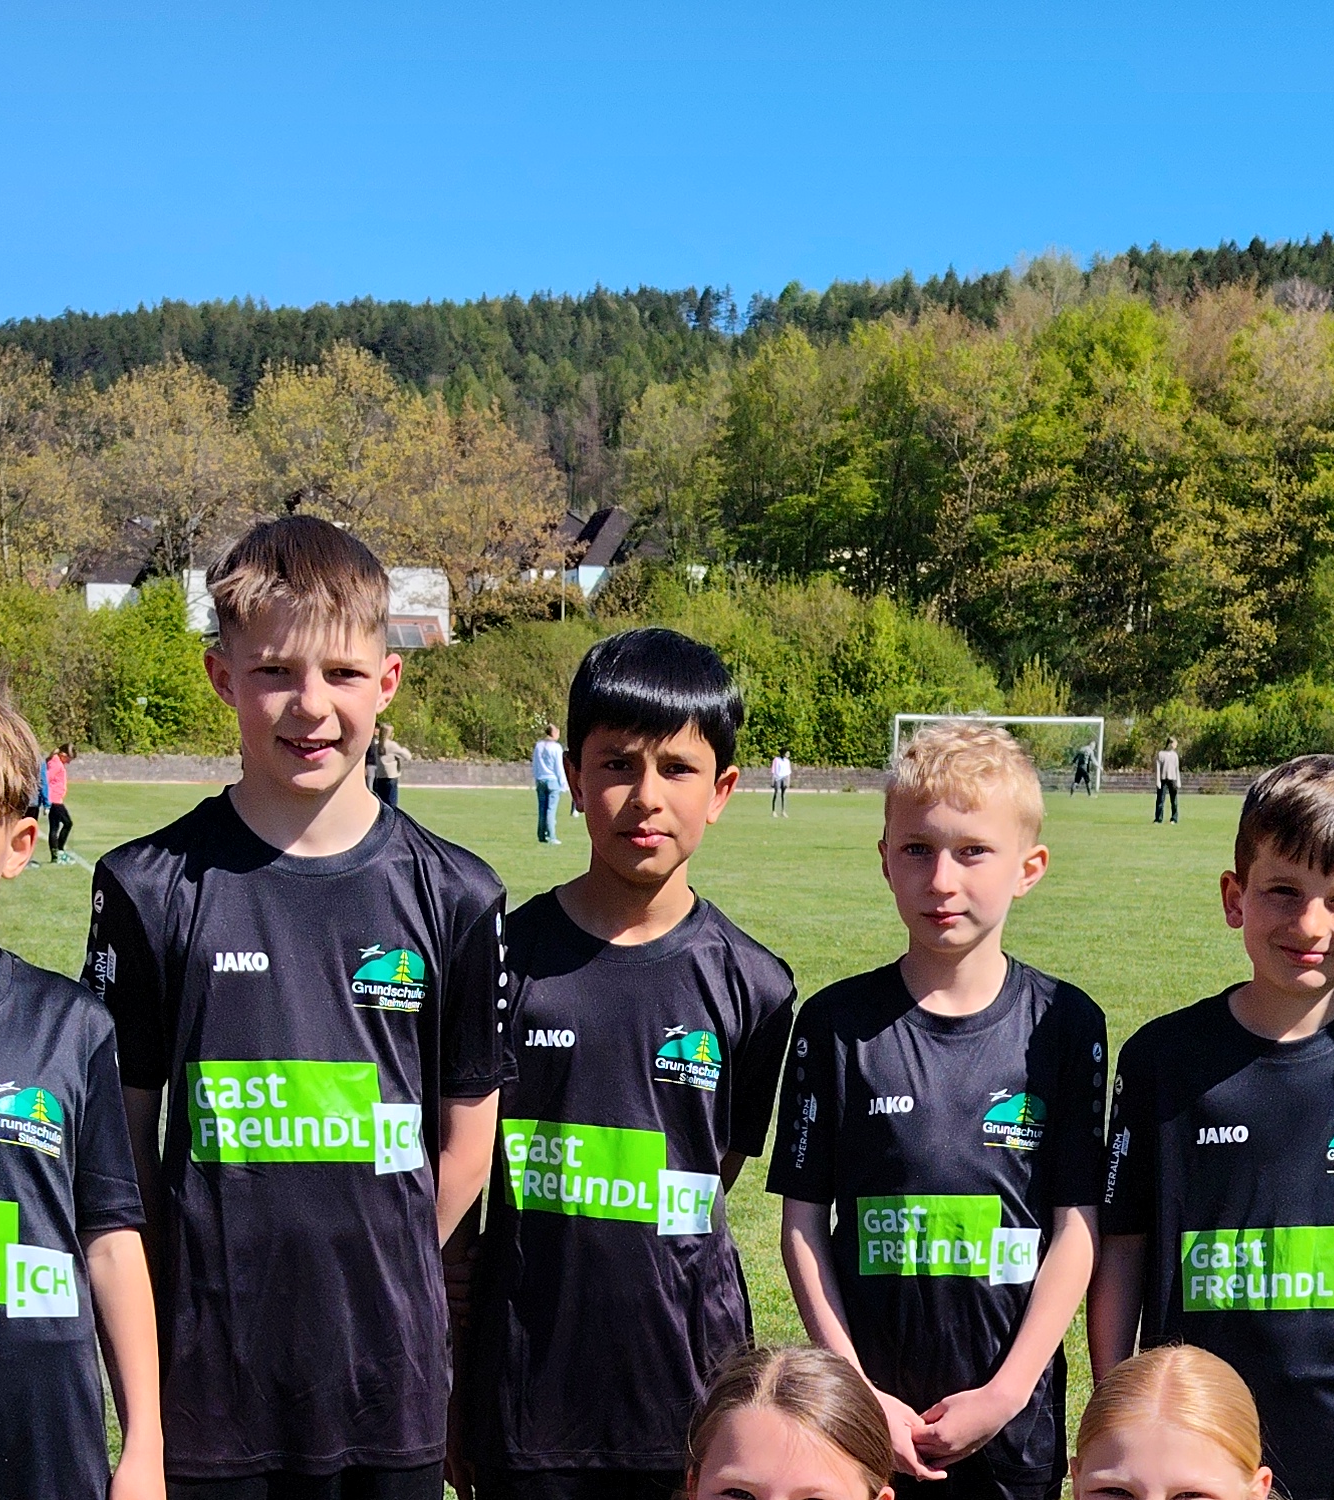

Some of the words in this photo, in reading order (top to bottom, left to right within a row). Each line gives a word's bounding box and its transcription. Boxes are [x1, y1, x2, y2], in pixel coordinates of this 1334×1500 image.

[213, 951, 269, 973] JAKO
[525, 1029, 576, 1048] JAKO
[195, 1073, 288, 1110] Gast
[868, 1095, 914, 1116] JAKO
[795, 1099, 810, 1169] FLYERALARM
[1197, 1125, 1249, 1145] JAKO
[504, 1133, 584, 1168] Gast
[1105, 1133, 1123, 1204] FLYERALARM
[863, 1205, 927, 1234] Gast
[1190, 1238, 1268, 1270] Gast
